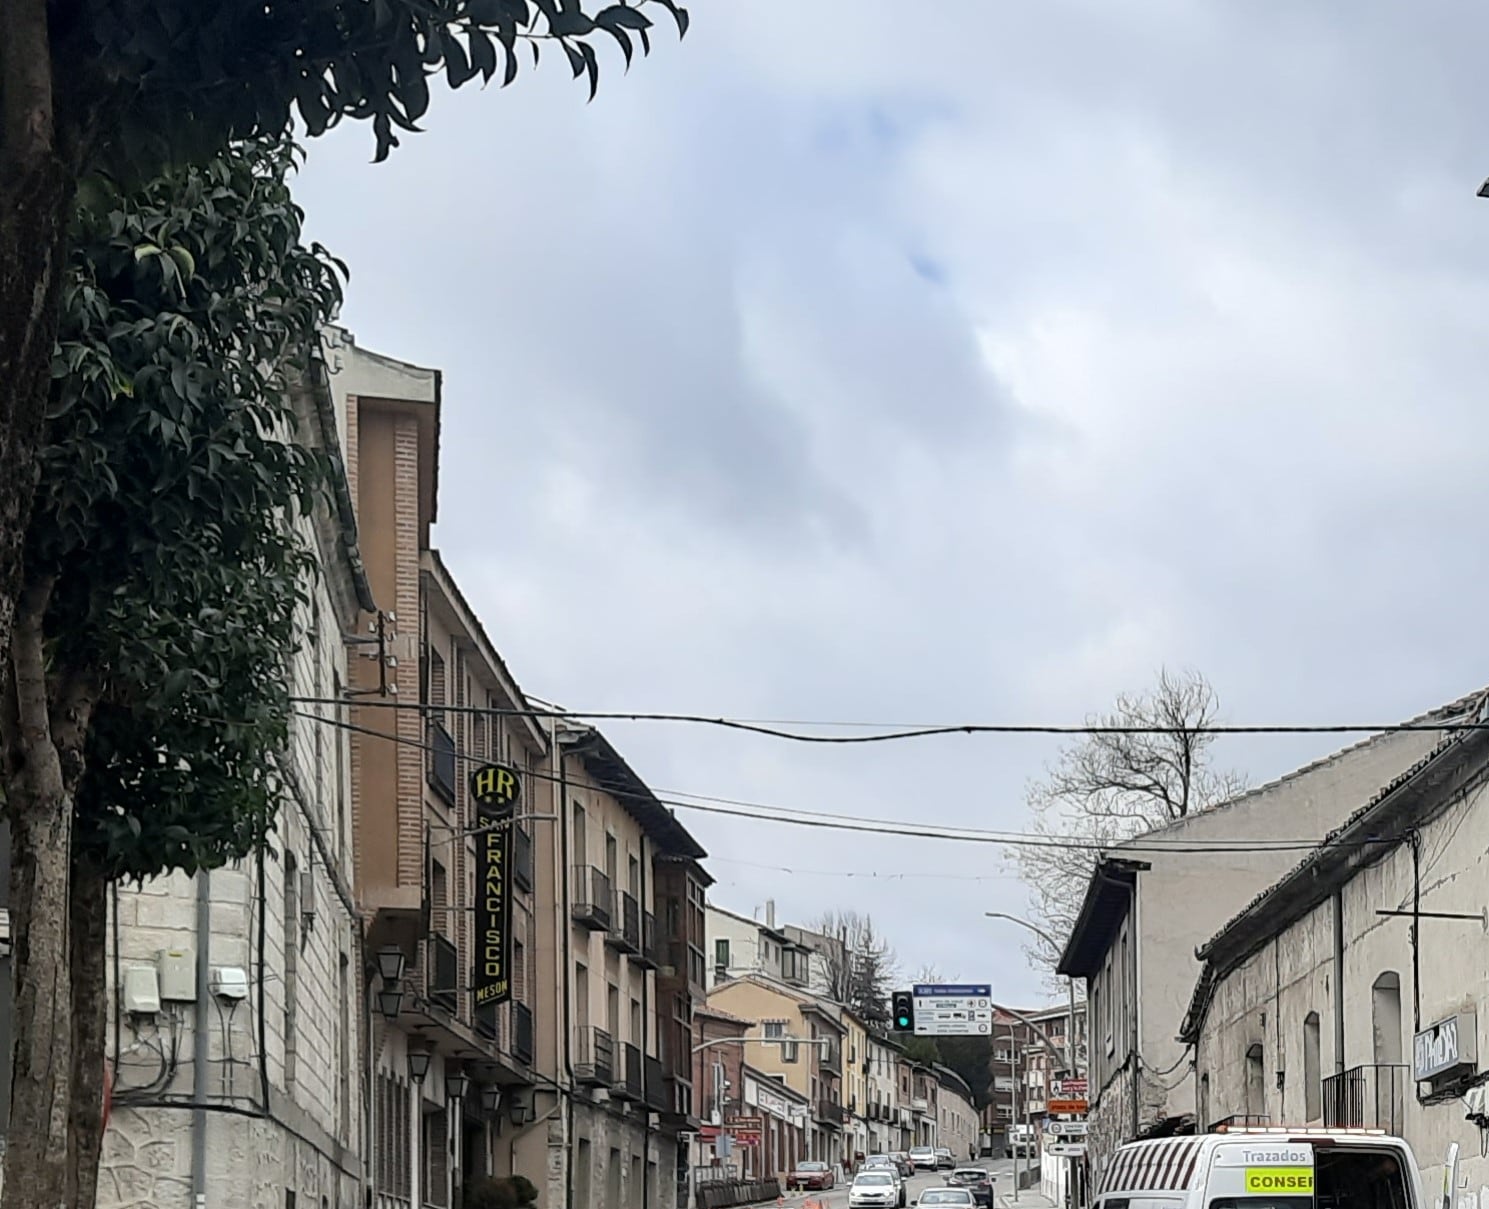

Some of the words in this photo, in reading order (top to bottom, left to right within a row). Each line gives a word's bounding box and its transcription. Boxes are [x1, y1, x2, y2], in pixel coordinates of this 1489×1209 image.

[476, 768, 514, 800] HR
[485, 833, 502, 977] FRANCISCO
[1242, 1149, 1306, 1162] Trazados
